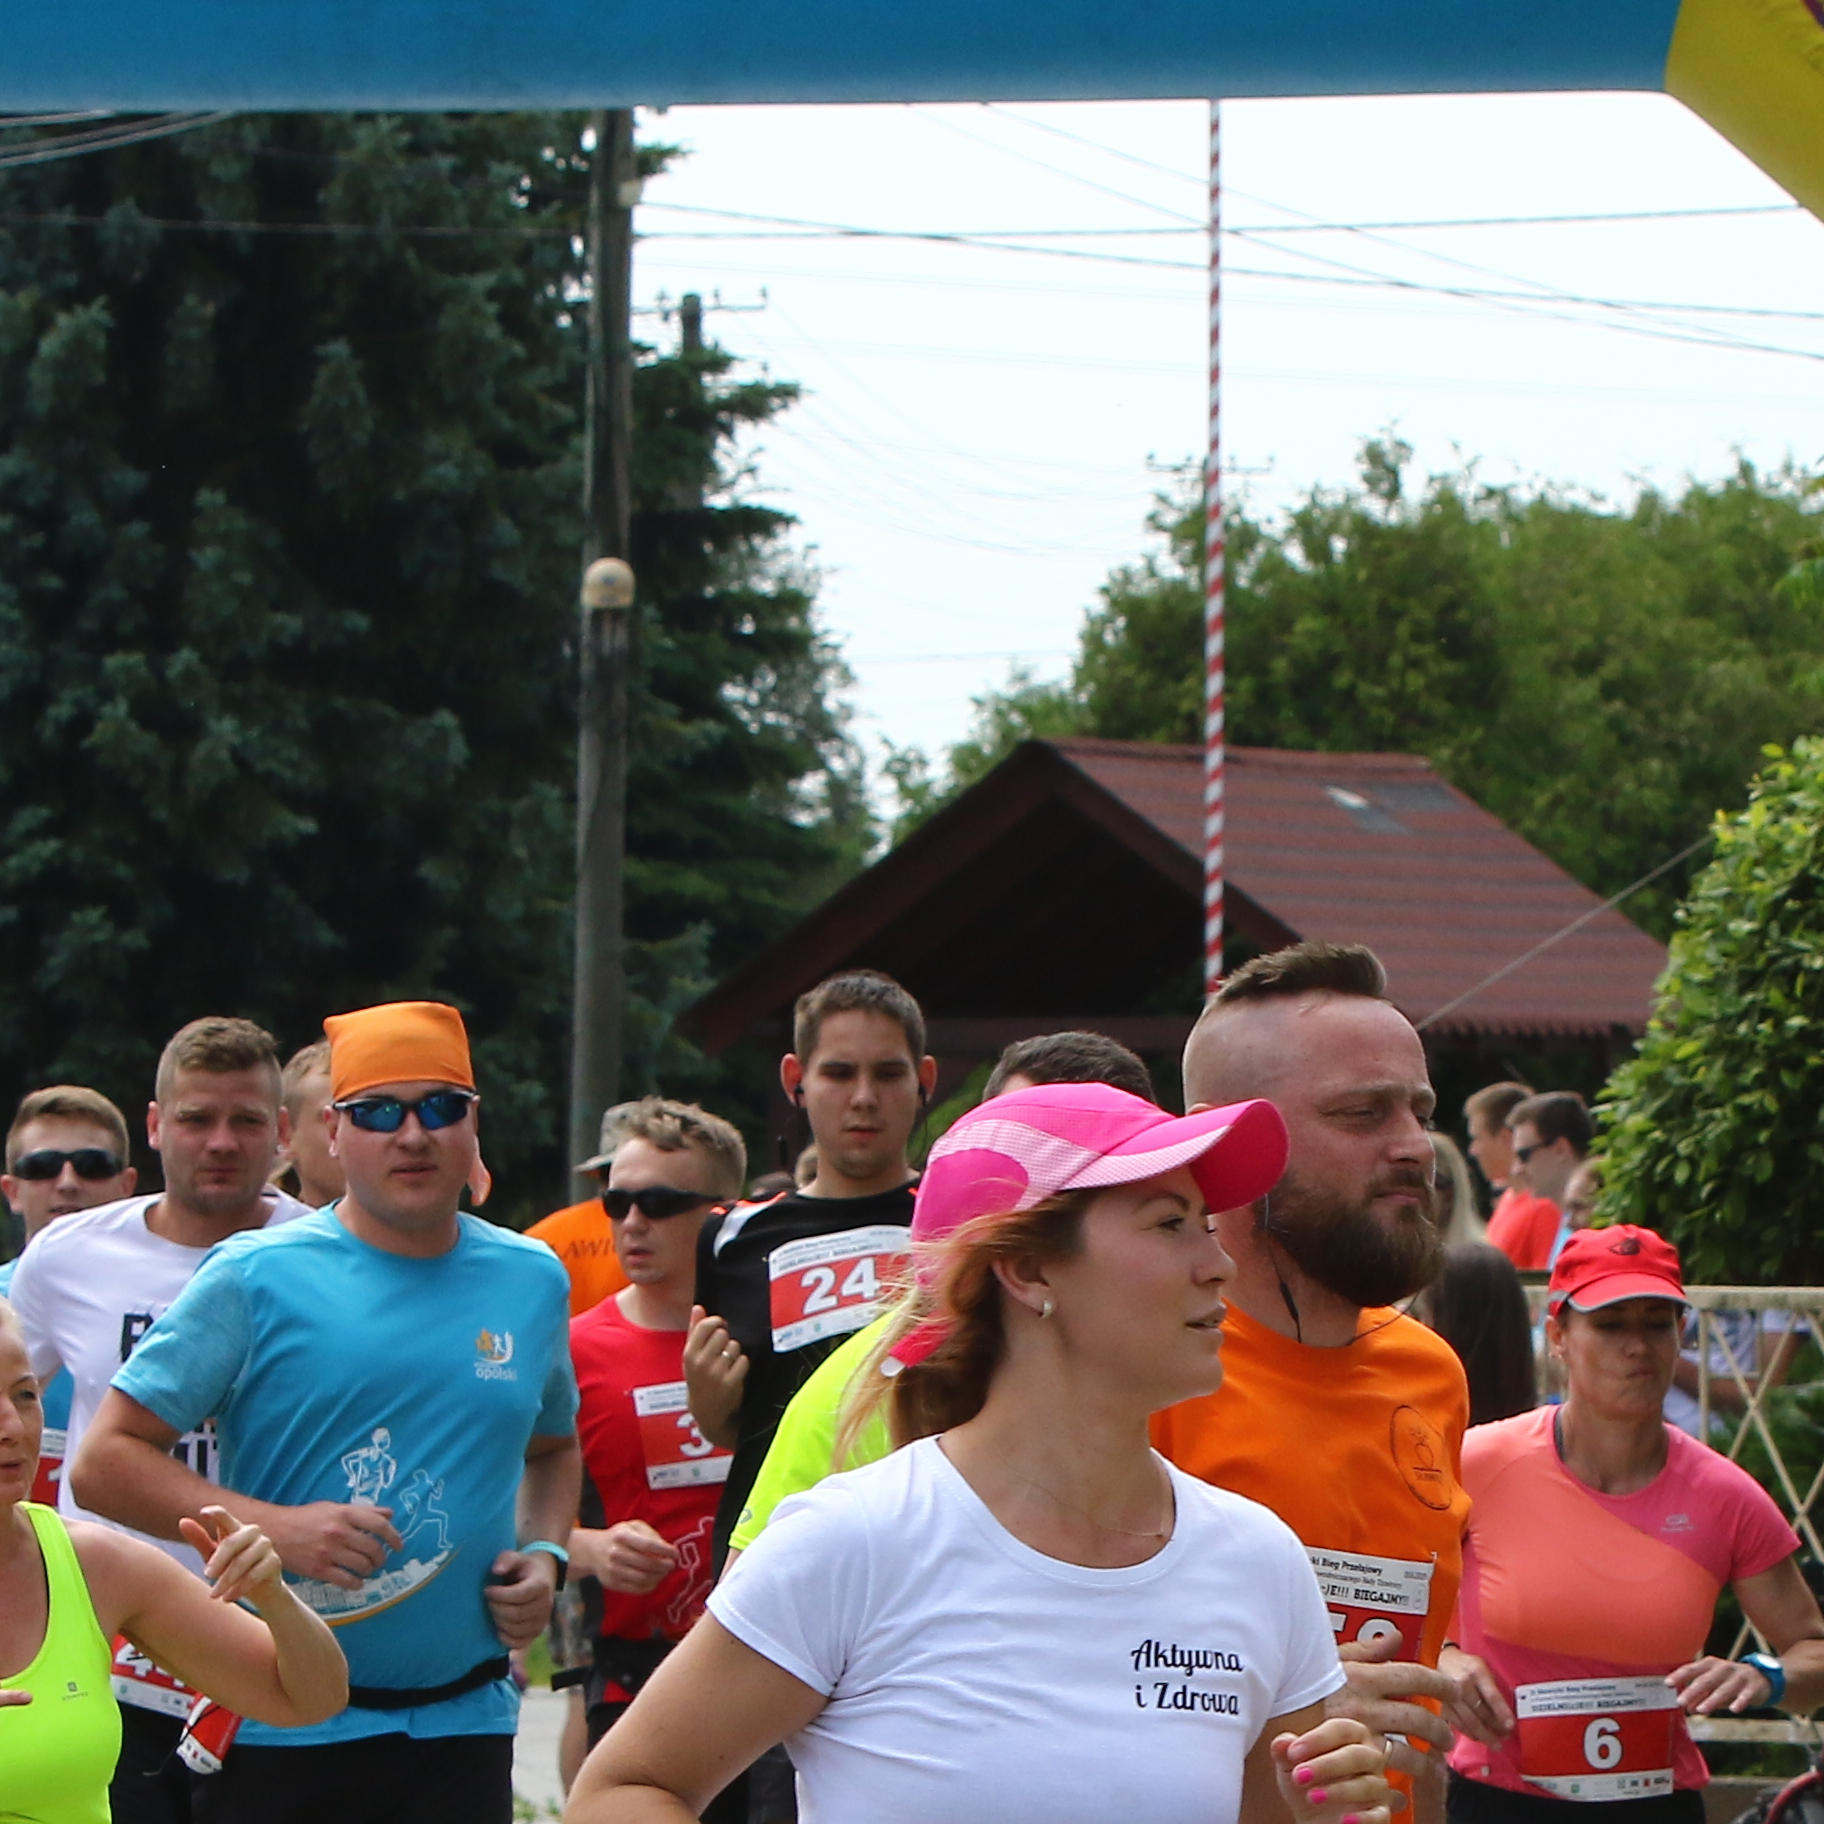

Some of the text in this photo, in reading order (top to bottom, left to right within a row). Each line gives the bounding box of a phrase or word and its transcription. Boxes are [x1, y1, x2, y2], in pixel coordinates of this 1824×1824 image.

[801, 1257, 882, 1315] 24
[1131, 1638, 1244, 1677] Aktywna
[1136, 1682, 1239, 1715] i Zdrowa
[1584, 1717, 1623, 1770] 6
